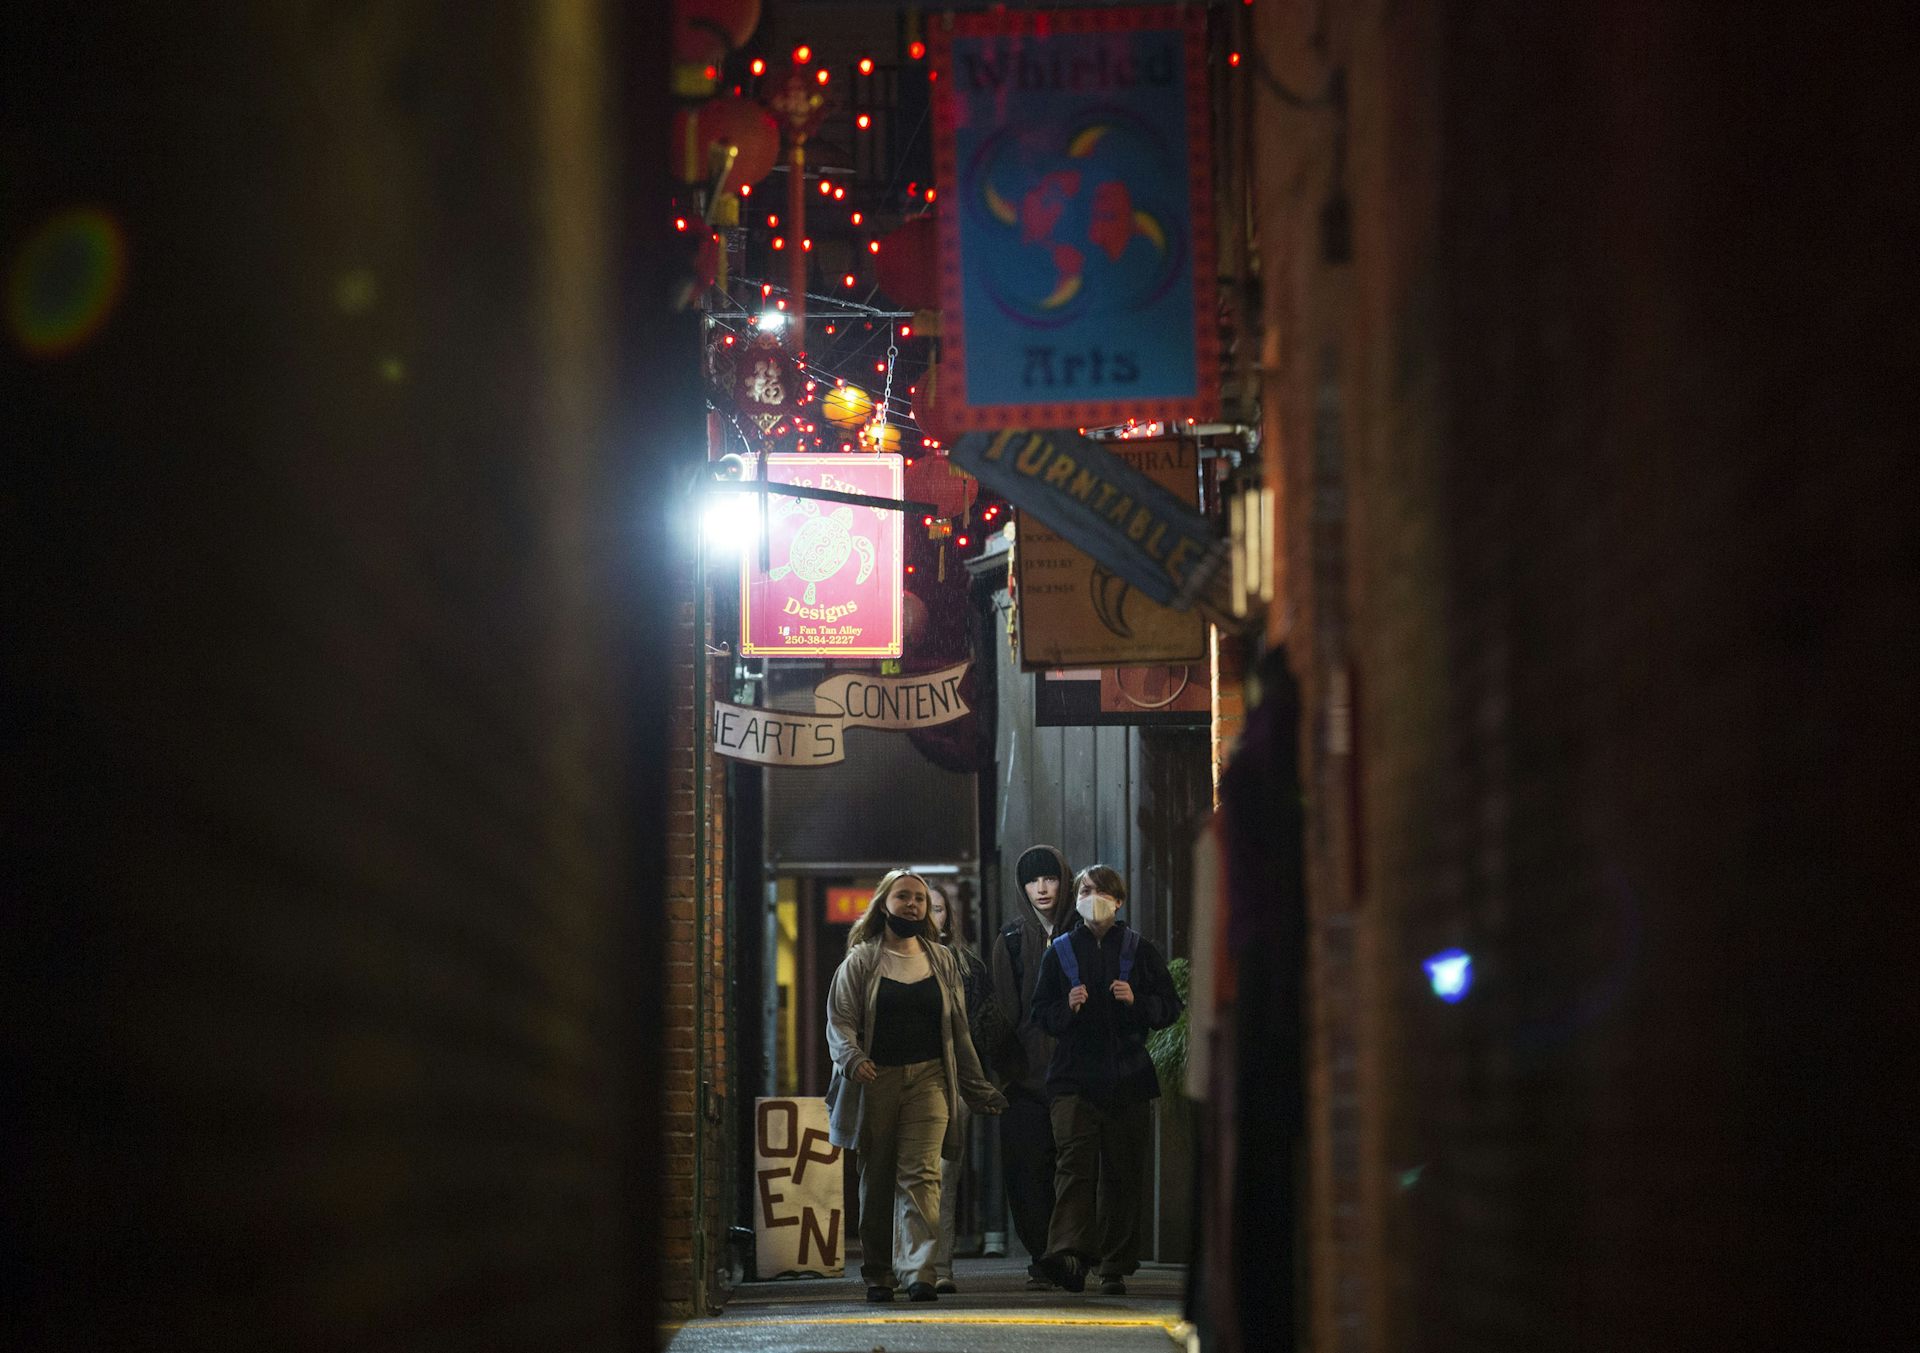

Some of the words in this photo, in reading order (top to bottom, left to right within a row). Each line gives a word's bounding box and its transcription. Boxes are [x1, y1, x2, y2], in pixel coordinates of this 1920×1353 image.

[960, 44, 1172, 90] Whirled
[1023, 344, 1139, 385] Arts
[1122, 450, 1190, 471] PIRAL
[985, 428, 1199, 584] TURNTABLE
[782, 596, 858, 623] Designs
[785, 635, 855, 645] 250-384-2227
[799, 626, 817, 635] Fan
[819, 626, 837, 635] Tan
[838, 626, 863, 637] Alley
[845, 676, 960, 721] CONTENT
[758, 1101, 842, 1267] OPEN
